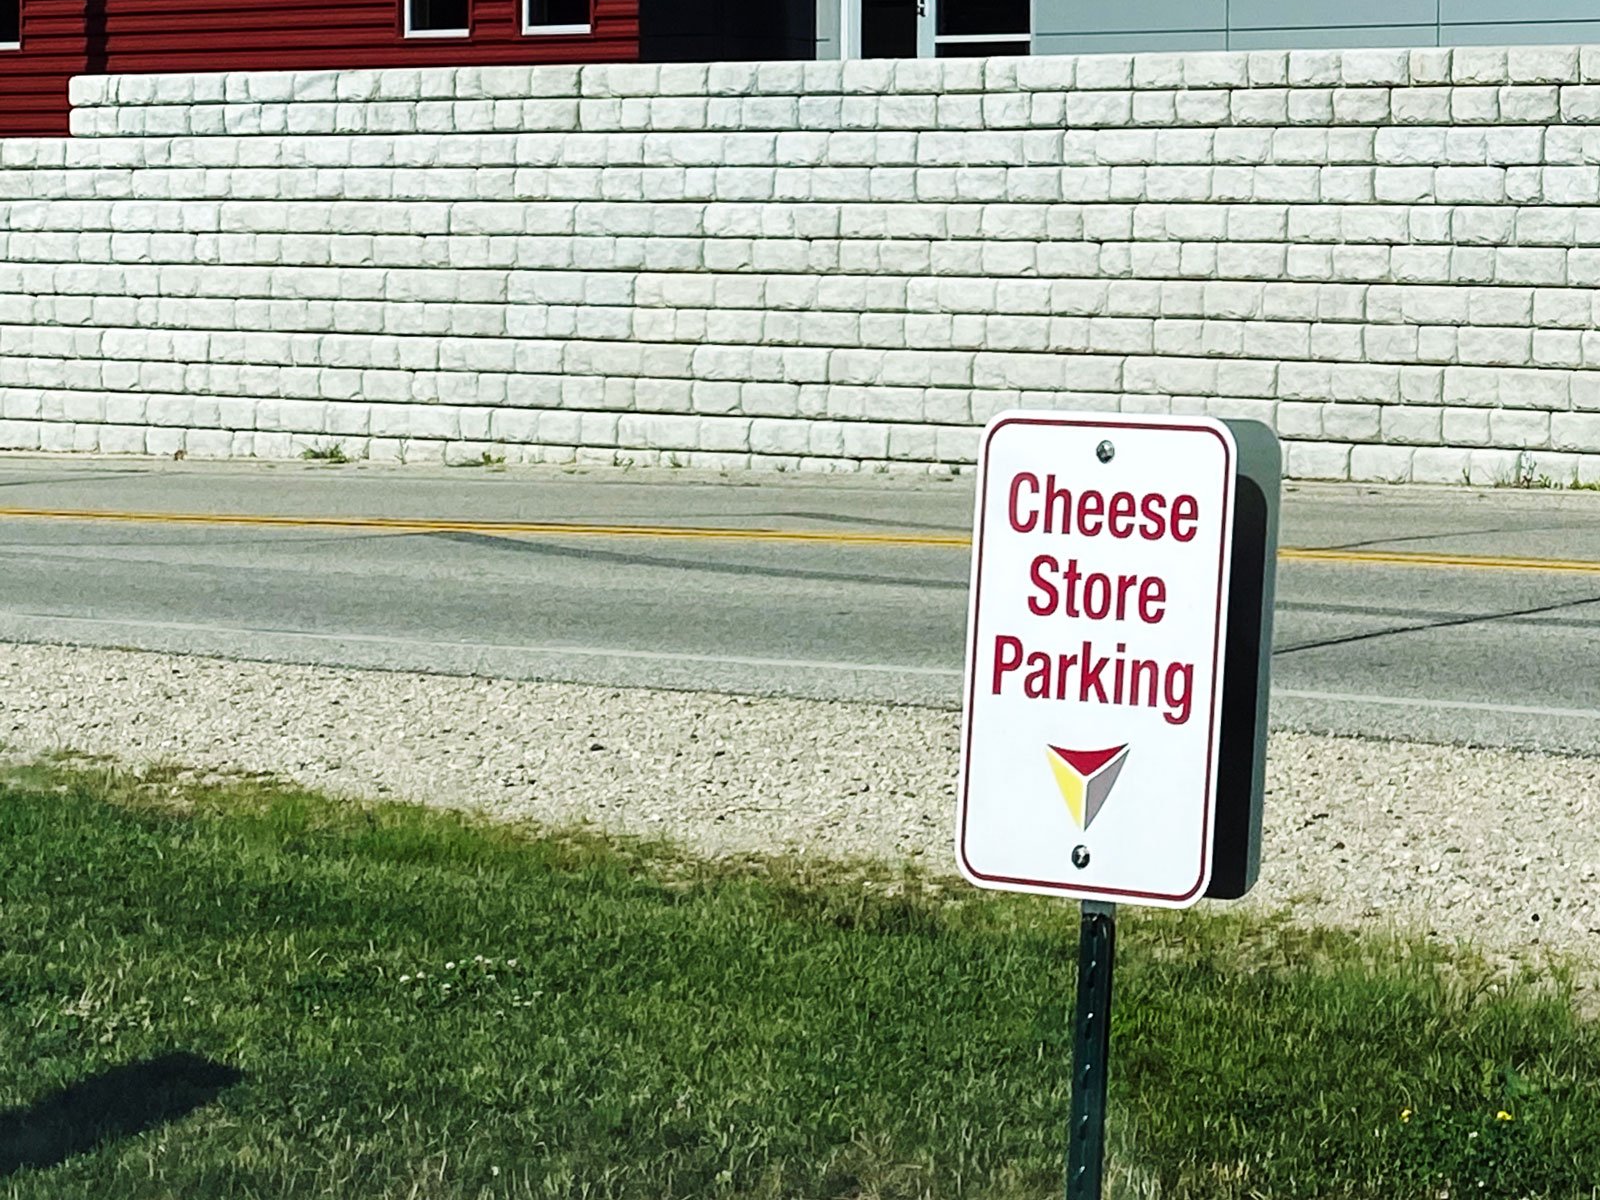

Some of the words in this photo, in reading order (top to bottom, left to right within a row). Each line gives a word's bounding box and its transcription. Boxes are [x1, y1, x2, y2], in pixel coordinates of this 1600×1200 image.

[1008, 472, 1199, 542] Cheese
[1027, 554, 1166, 624] Store
[992, 635, 1194, 725] Parking
